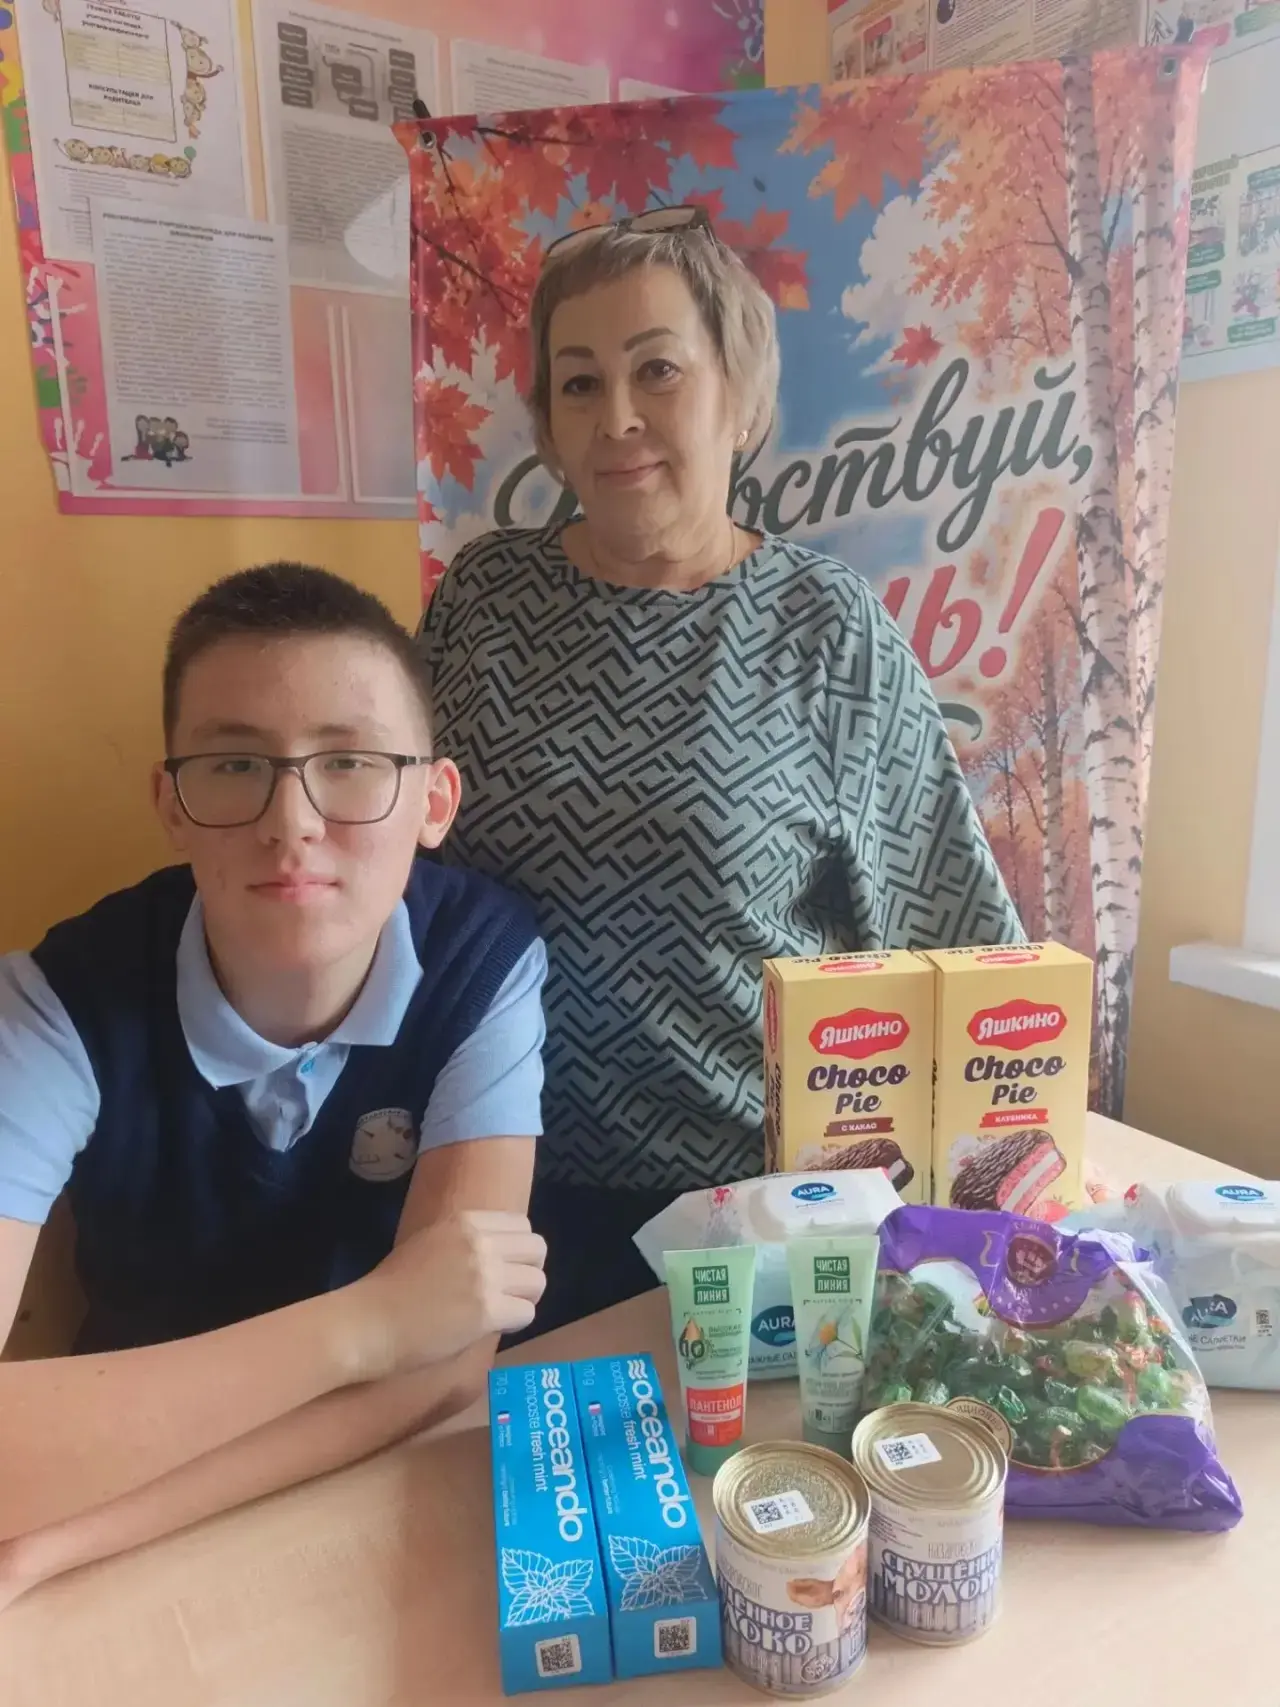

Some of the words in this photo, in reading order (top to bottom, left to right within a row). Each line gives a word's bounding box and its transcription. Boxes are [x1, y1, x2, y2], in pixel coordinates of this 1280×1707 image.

[807, 1063, 911, 1092] Choco
[964, 1054, 1067, 1083] Choco
[835, 1092, 882, 1115] Pie
[991, 1082, 1038, 1106] Pie
[849, 1121, 878, 1132] КАКАО
[796, 1184, 829, 1197] AURA
[1222, 1188, 1258, 1197] AURA
[694, 1269, 728, 1284] ЧИСТАЯ
[815, 1258, 848, 1273] ЧИСТАЯ
[696, 1289, 728, 1303] ЛИНИЯ
[817, 1279, 849, 1292] ЛИНИЯ
[690, 1396, 741, 1413] ПАНТЕНОЛ
[530, 1430, 545, 1462] fresh
[623, 1419, 643, 1451] fresh
[543, 1388, 588, 1542] oceando
[632, 1377, 689, 1530] oceando
[532, 1463, 549, 1493] mint
[630, 1451, 648, 1481] mint
[884, 1567, 998, 1605] МОЛОК
